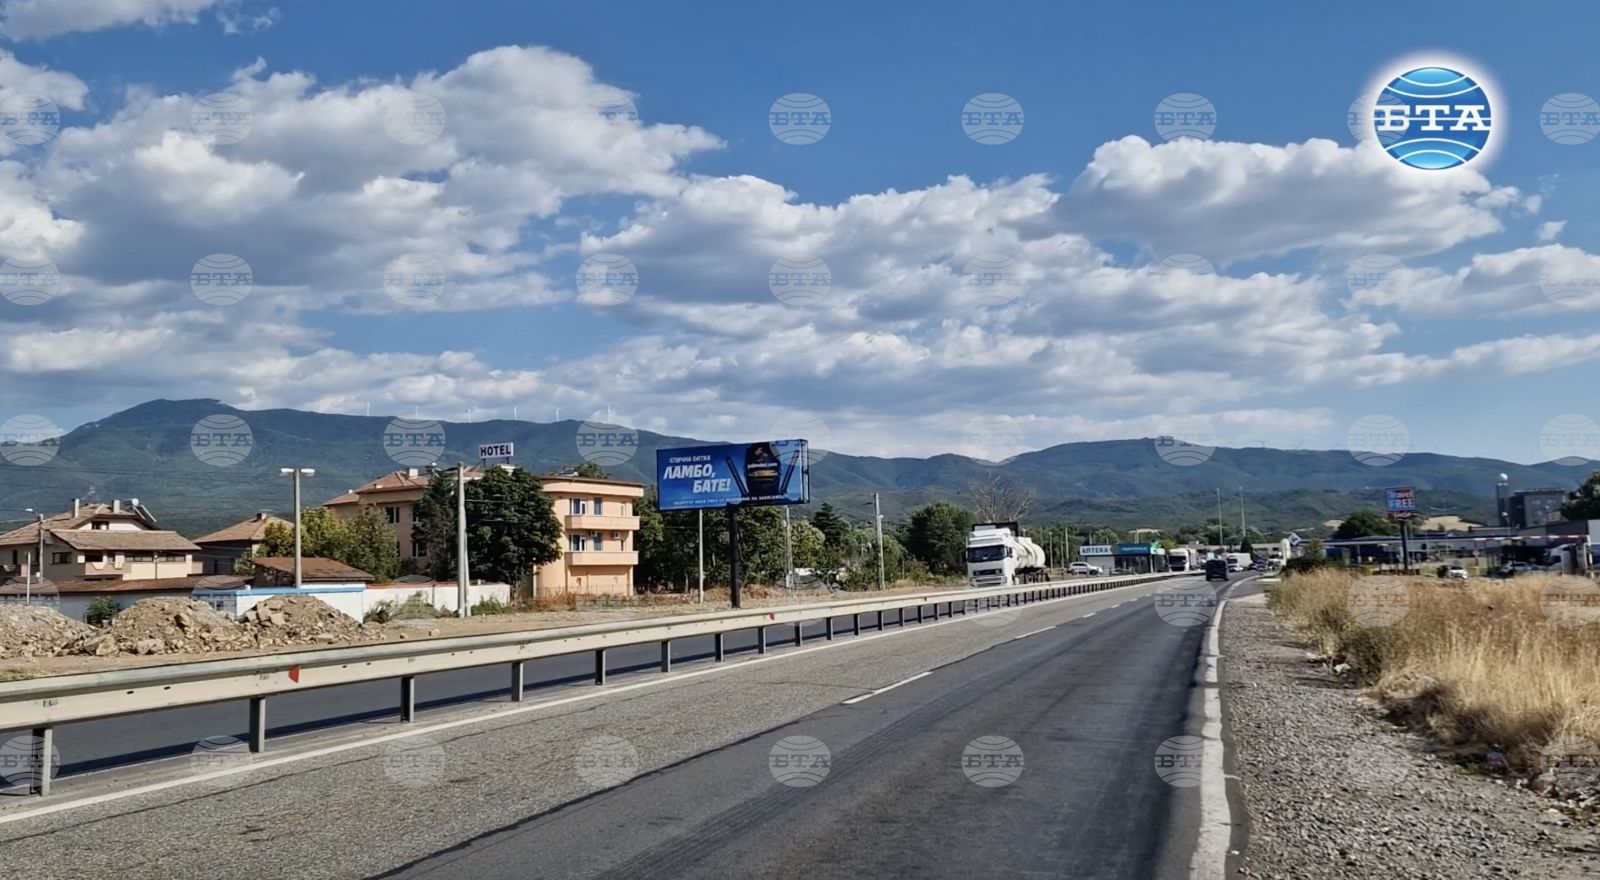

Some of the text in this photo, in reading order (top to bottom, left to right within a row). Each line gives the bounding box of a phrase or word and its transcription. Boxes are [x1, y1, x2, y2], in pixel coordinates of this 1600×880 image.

[480, 445, 511, 457] HOTEL
[663, 463, 716, 480] ЛАМБО,
[692, 478, 731, 494] БАТЕ!
